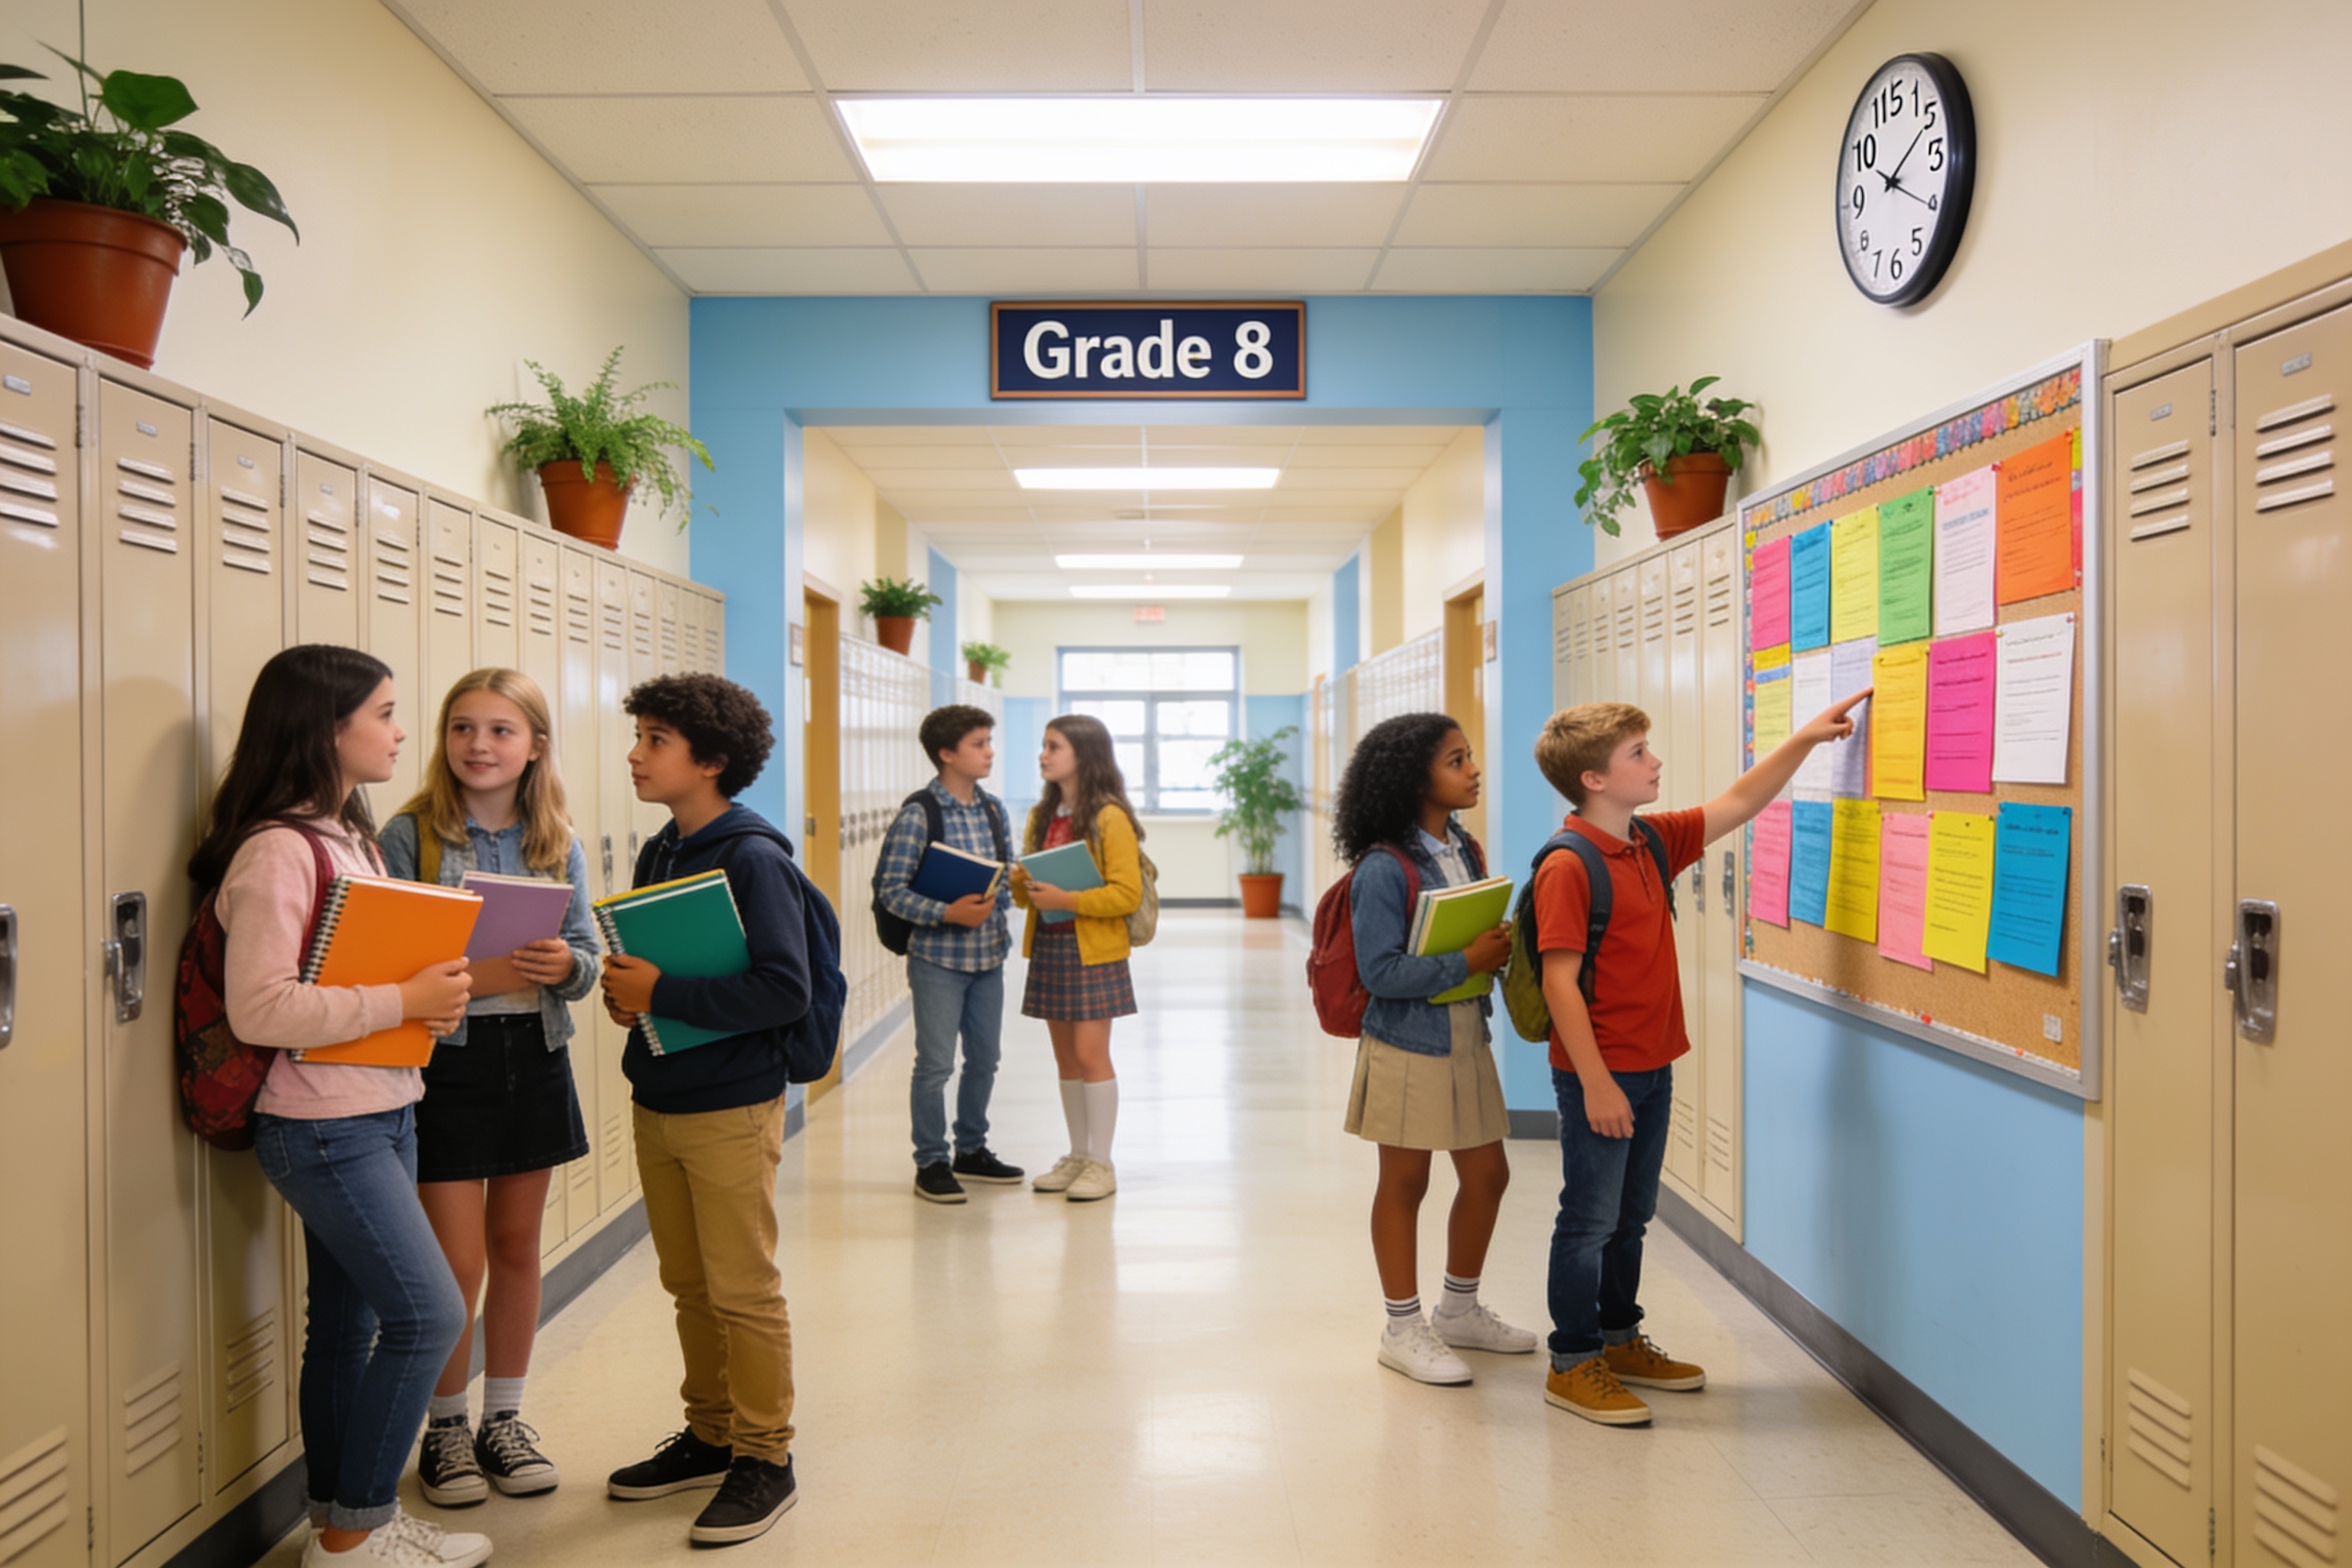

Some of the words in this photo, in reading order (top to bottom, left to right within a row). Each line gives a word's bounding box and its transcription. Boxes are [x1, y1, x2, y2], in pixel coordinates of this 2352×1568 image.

[1911, 79, 1919, 117] 1
[1924, 101, 1936, 130] 5
[1853, 134, 1877, 172] 10
[1928, 138, 1943, 172] 3
[1853, 185, 1865, 219] 9
[1912, 227, 1923, 256] 5
[1890, 248, 1903, 279] 6
[1023, 319, 1212, 379] Grade
[1233, 320, 1274, 379] 8
